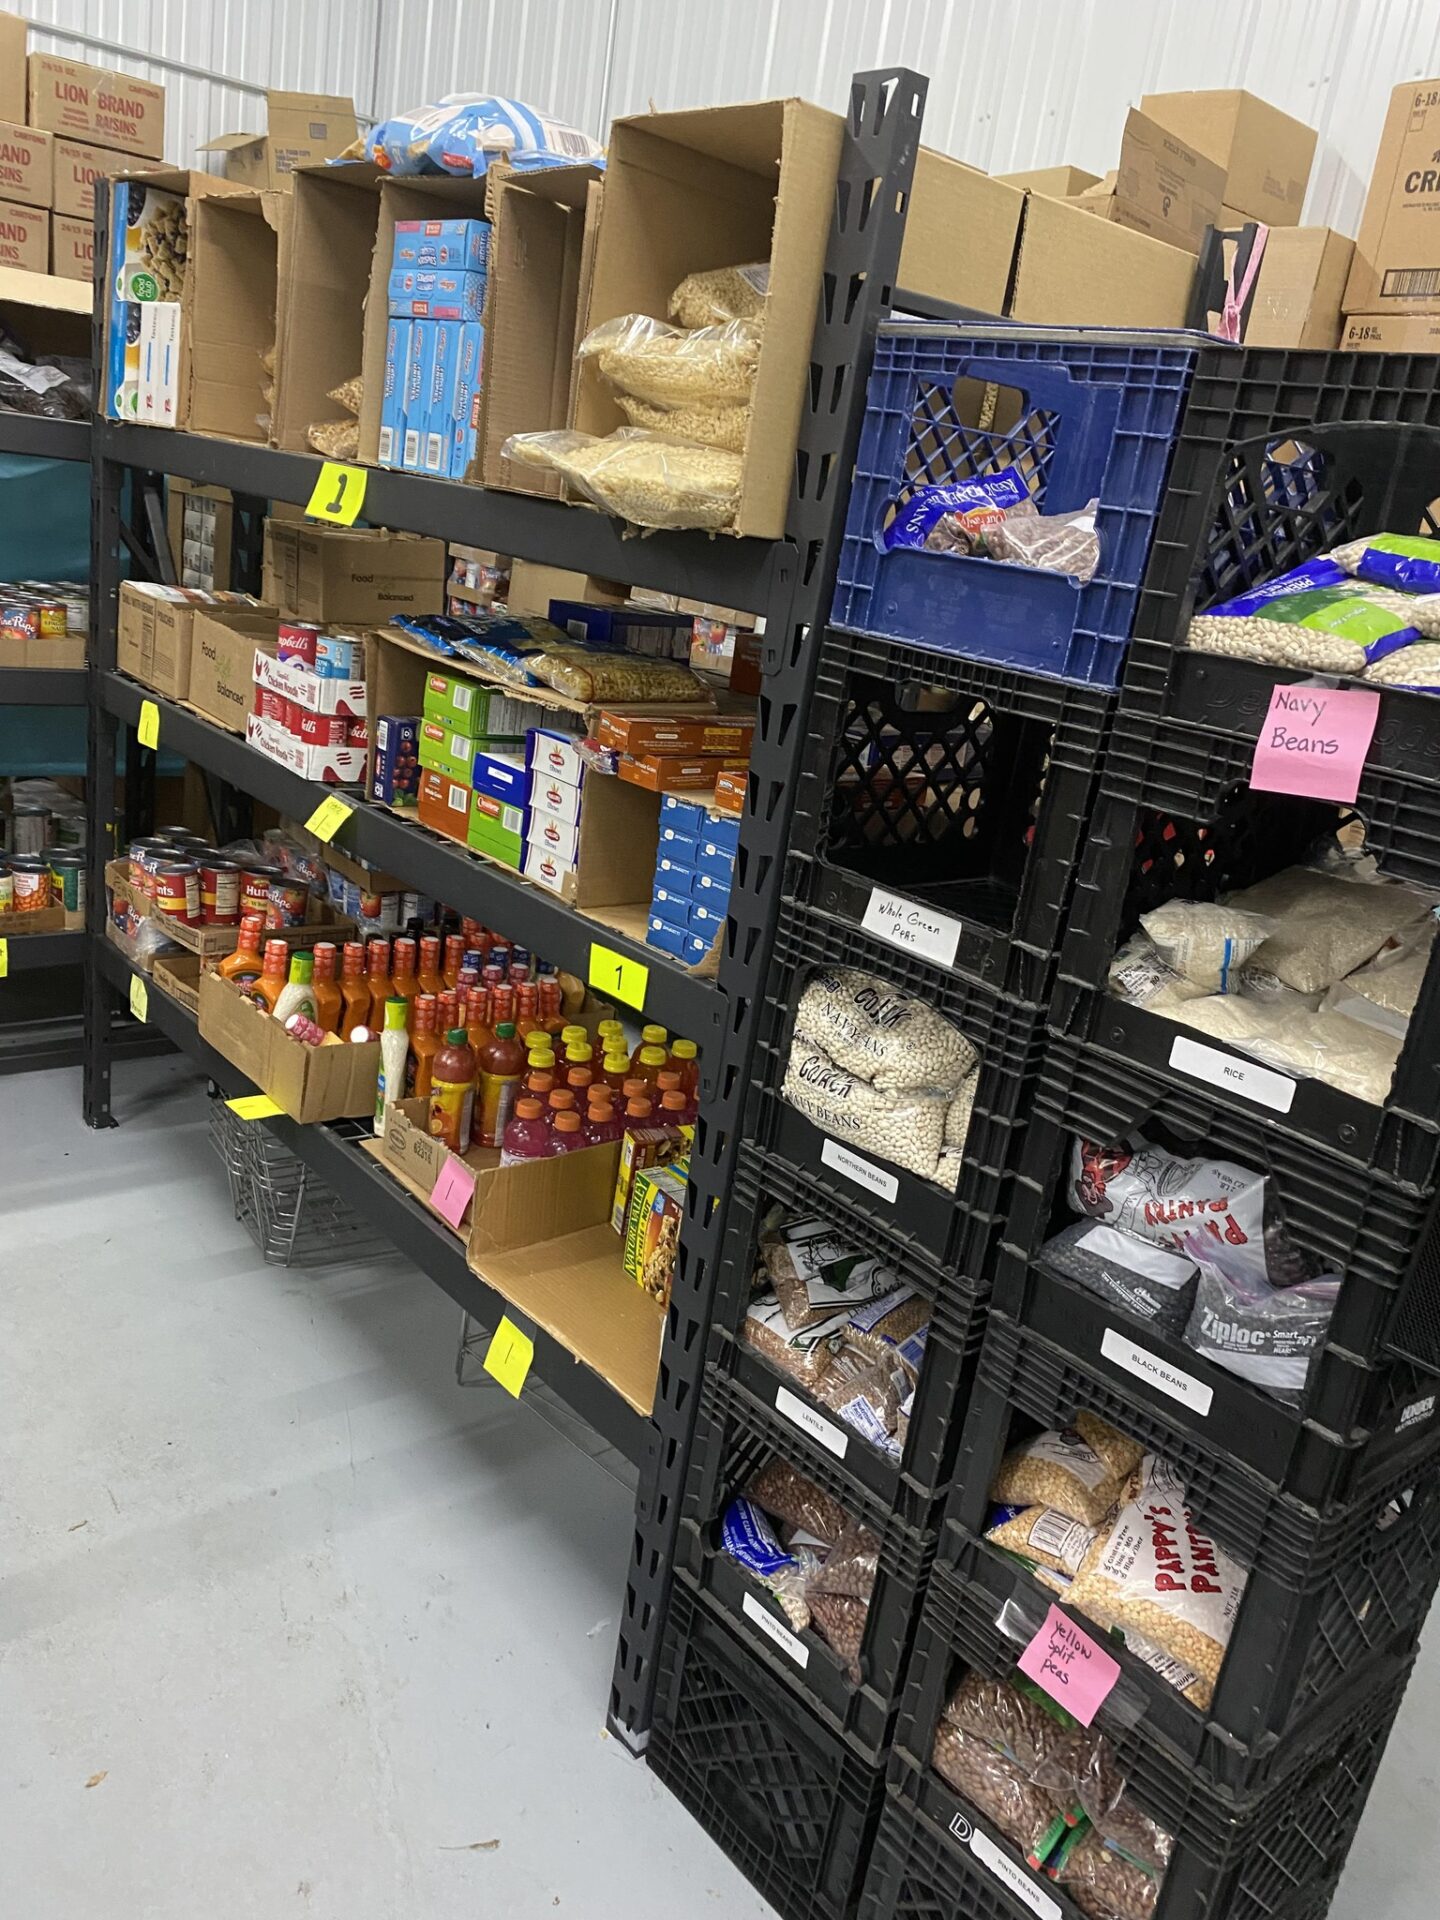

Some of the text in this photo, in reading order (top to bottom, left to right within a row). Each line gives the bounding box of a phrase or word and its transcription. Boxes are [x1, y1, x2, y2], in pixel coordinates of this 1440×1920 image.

[55, 81, 89, 105] LION
[97, 92, 145, 119] BRAND
[95, 114, 137, 136] RAISINS
[0, 144, 31, 166] AND
[0, 225, 27, 243] AND
[74, 241, 94, 260] LIO
[1349, 327, 1370, 340] 6-18
[351, 574, 374, 583] Food
[378, 593, 414, 601] Balanced
[14, 616, 36, 632] Ripe
[202, 641, 216, 660] Food
[279, 635, 308, 650] pbell's
[217, 681, 244, 706] Balanced
[1275, 691, 1327, 726] Navy
[1271, 726, 1339, 755] Beans
[246, 885, 269, 897] Hun
[270, 891, 291, 909] Ripe
[878, 901, 941, 935] Whole Green
[615, 965, 623, 991] 1
[821, 1002, 889, 1058] NAVY ANS
[1223, 1065, 1245, 1082] RICE
[816, 1106, 862, 1131] BEANS
[837, 1154, 888, 1188] NORTHERN BEANS
[642, 1199, 651, 1222] NUT
[625, 1177, 650, 1277] NATURE VALLEY
[1200, 1305, 1267, 1348] Ziploc
[1272, 1330, 1299, 1340] Smart
[1131, 1353, 1188, 1392] BLACK BEANS
[801, 1412, 824, 1433] LENTILS
[1119, 1525, 1129, 1540] Free
[1143, 1505, 1187, 1592] PAPPY'S
[1122, 1554, 1136, 1571] High
[997, 1858, 1041, 1904] PINTO BEANS
